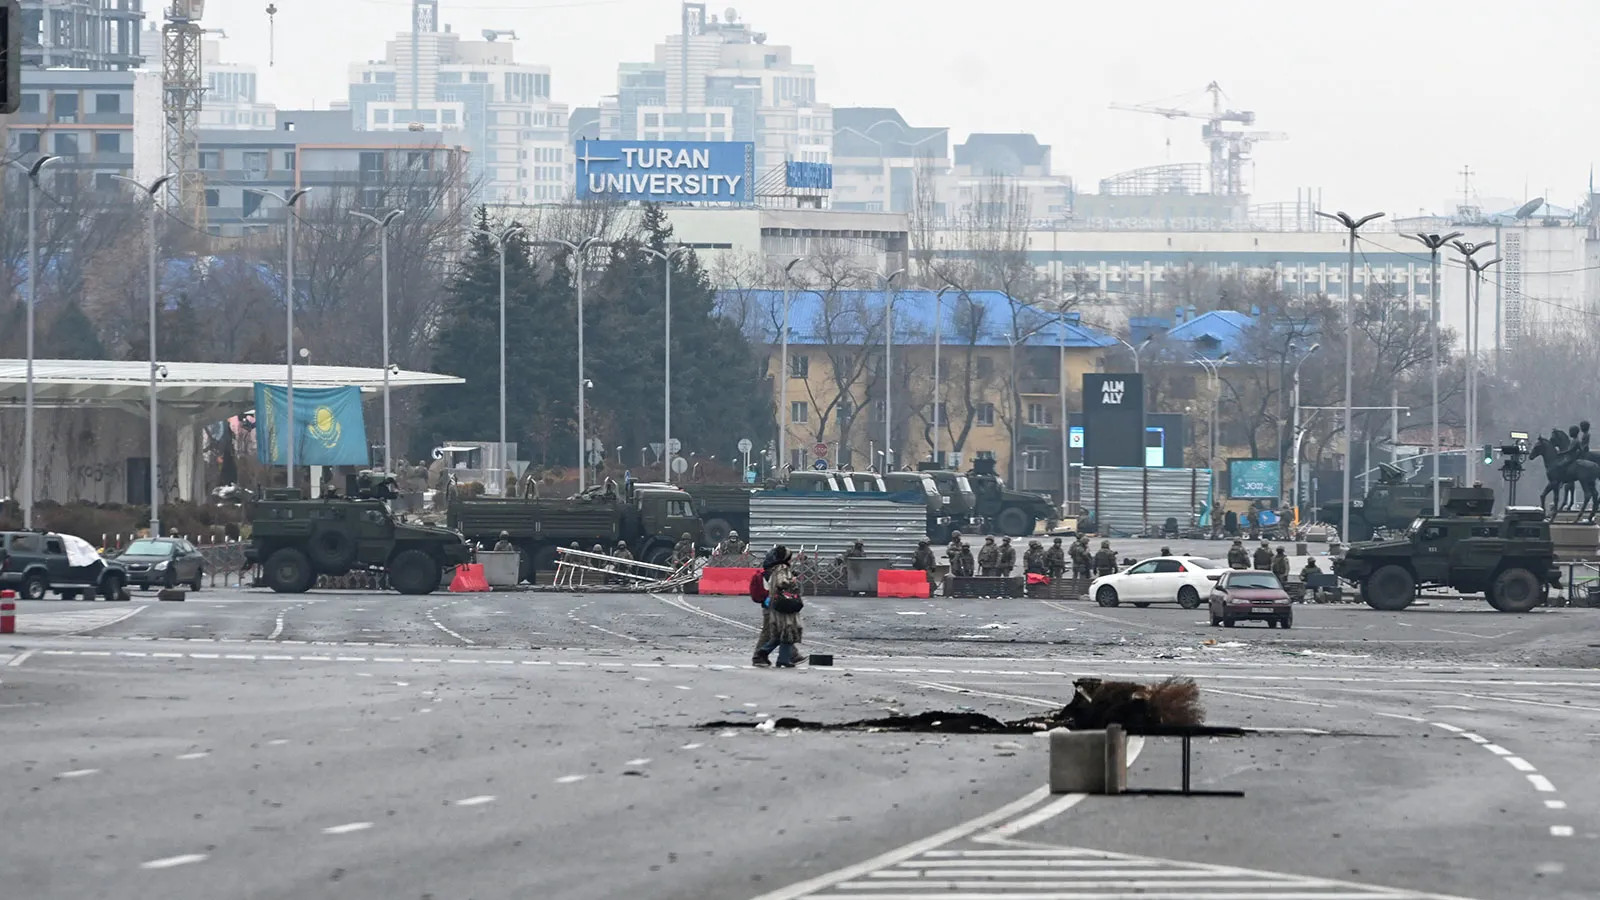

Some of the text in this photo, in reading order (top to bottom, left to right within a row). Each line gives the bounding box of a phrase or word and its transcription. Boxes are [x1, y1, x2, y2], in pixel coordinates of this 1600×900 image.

[621, 147, 709, 168] TURAN
[589, 173, 741, 195] UNIVERSITY
[1101, 380, 1124, 392] ALM
[1102, 392, 1124, 404] ALY
